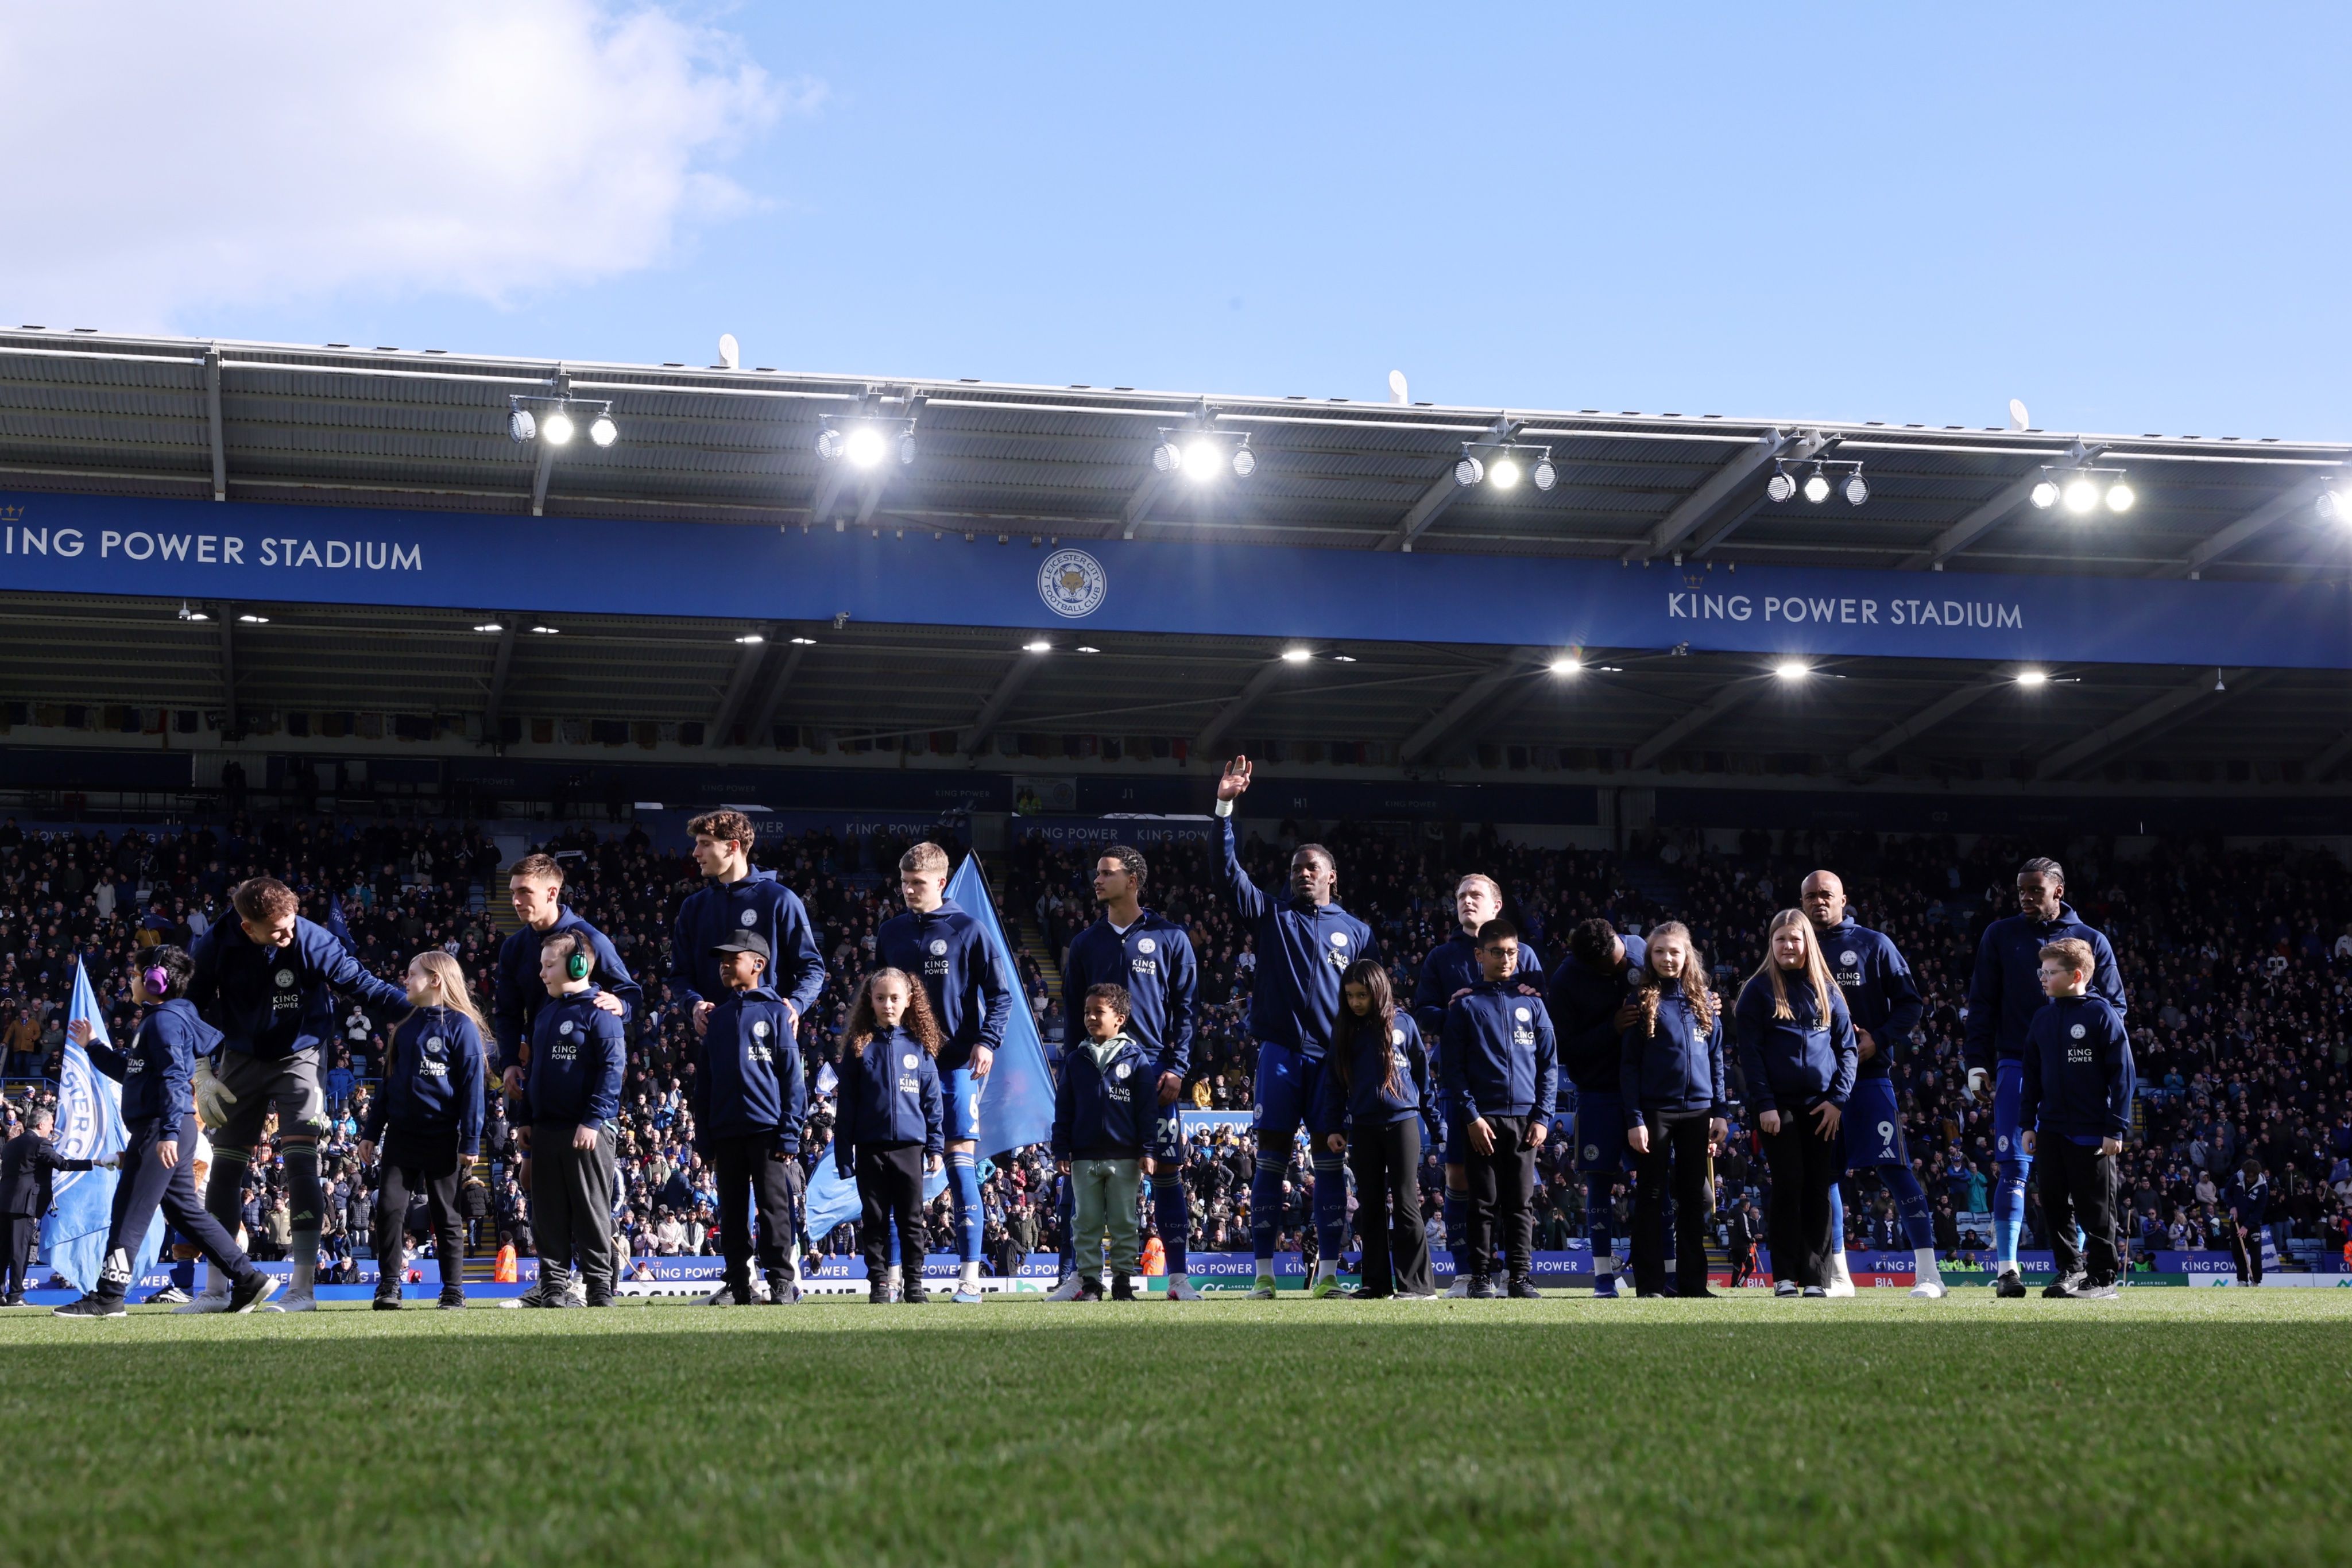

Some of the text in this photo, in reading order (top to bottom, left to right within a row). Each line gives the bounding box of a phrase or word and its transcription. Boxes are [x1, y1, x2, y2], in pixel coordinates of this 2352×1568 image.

[6, 526, 423, 571] ING POWER STADIUM
[1045, 555, 1101, 582] LEICESTER CITY
[1045, 584, 1101, 612] FOOTBALL CLUB
[1668, 593, 2023, 629] KING POWER STADIUM
[960, 790, 991, 798] POWER
[1121, 788, 1134, 799] J1
[1293, 797, 1307, 808] H1
[1384, 800, 1406, 808] KING
[1932, 811, 1949, 822] G2
[753, 822, 784, 833] WER
[1026, 827, 1118, 840] KNG POWER
[1178, 830, 1209, 841] POW
[1328, 950, 1348, 965] KING
[924, 960, 949, 968] KING
[1132, 959, 1156, 969] KING
[1328, 958, 1347, 970] POWER
[1131, 966, 1155, 975] POWER
[273, 994, 299, 1004] KING
[273, 1002, 299, 1011] POWER
[1514, 1030, 1534, 1039] KING
[748, 1046, 772, 1055] KING
[2068, 1048, 2093, 1056] KING
[1394, 1052, 1407, 1062] NG
[420, 1061, 447, 1070] KING
[419, 1068, 446, 1077] POWER
[1109, 1086, 1131, 1097] KING
[314, 1086, 323, 1114] 1
[1109, 1093, 1131, 1103] POWER
[969, 1093, 978, 1120] 6
[1156, 1117, 1179, 1144] 29
[1213, 1121, 1254, 1135] POW
[1877, 1121, 1894, 1146] 9
[1901, 1194, 1924, 1206] LCFC
[956, 1205, 977, 1213] LCFC
[804, 1265, 849, 1277] POWER
[921, 1265, 962, 1275] POWE
[1035, 1264, 1059, 1275] POW
[1187, 1264, 1253, 1274] NG POWER
[1286, 1263, 1307, 1273] KIN
[1430, 1262, 1455, 1272] POW
[1537, 1261, 1578, 1271] POWER
[1875, 1261, 1905, 1271] KING
[1979, 1261, 1998, 1271] KIN
[2181, 1261, 2237, 1271] KING POW
[2339, 1263, 2350, 1272] KI
[100, 1267, 133, 1284] didas
[525, 1270, 538, 1281] KI
[684, 1268, 727, 1279] POWE
[140, 1276, 169, 1288] WER
[1746, 1278, 1766, 1287] BIA
[1874, 1277, 1894, 1287] BIA
